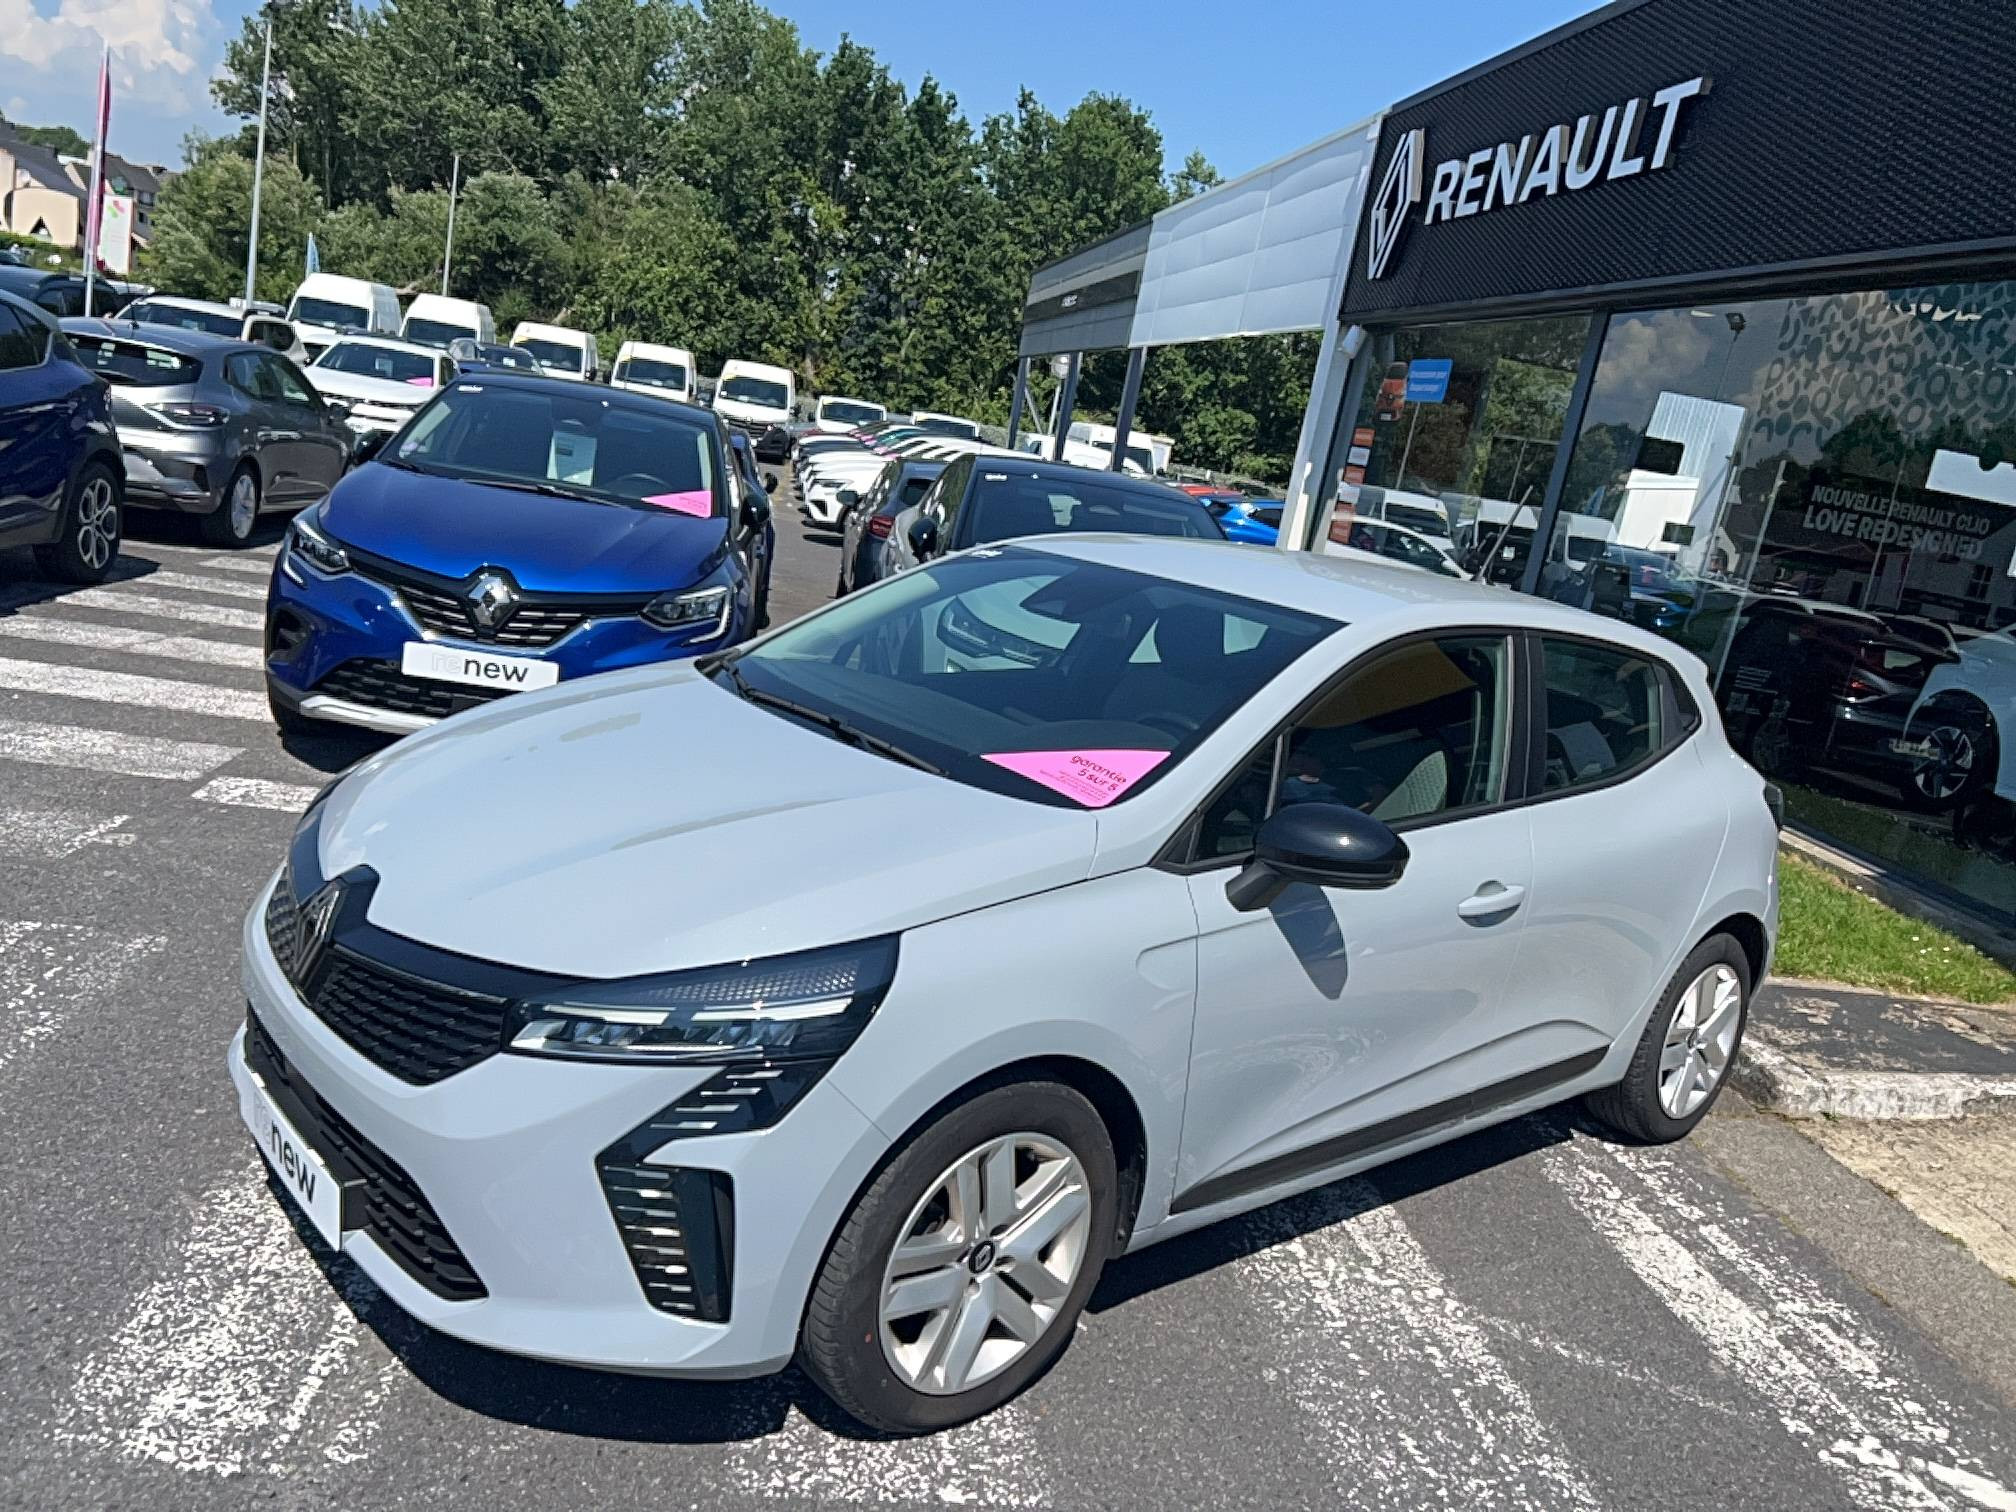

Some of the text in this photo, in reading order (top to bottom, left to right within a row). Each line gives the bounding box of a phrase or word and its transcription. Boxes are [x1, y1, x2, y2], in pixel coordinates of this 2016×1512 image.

[1423, 76, 1706, 226] RENAULT
[1811, 484, 1991, 536] NOUVELLE RENAULT CLIO
[1802, 504, 1984, 561] LOVE REDESIGNED
[431, 653, 529, 683] renew
[1070, 755, 1127, 785] garantie
[1077, 768, 1088, 777] 5
[1086, 774, 1109, 786] sur
